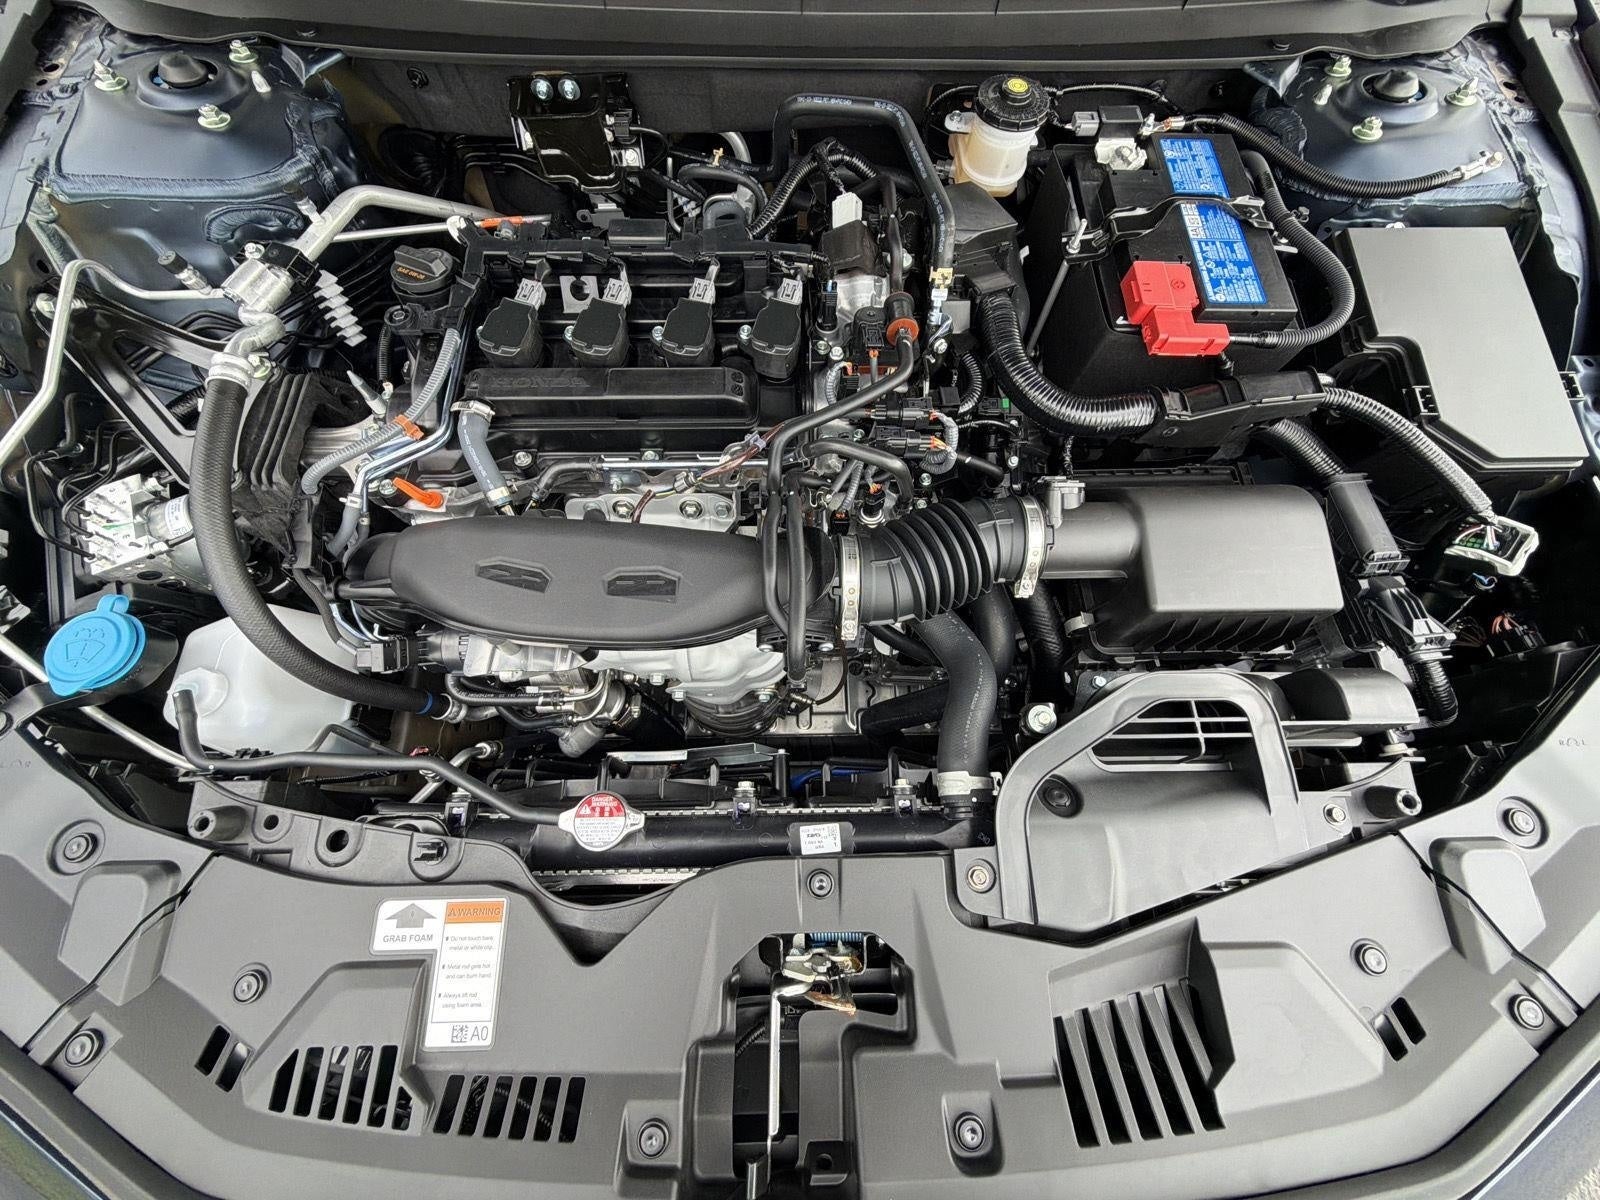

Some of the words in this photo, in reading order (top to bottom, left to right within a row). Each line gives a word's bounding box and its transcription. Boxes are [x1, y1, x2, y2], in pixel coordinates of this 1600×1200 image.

[489, 375, 591, 388] HONDA
[457, 906, 502, 917] WARNING
[382, 934, 408, 943] GRAB
[408, 933, 434, 943] FOAM
[470, 1025, 489, 1041] A0
